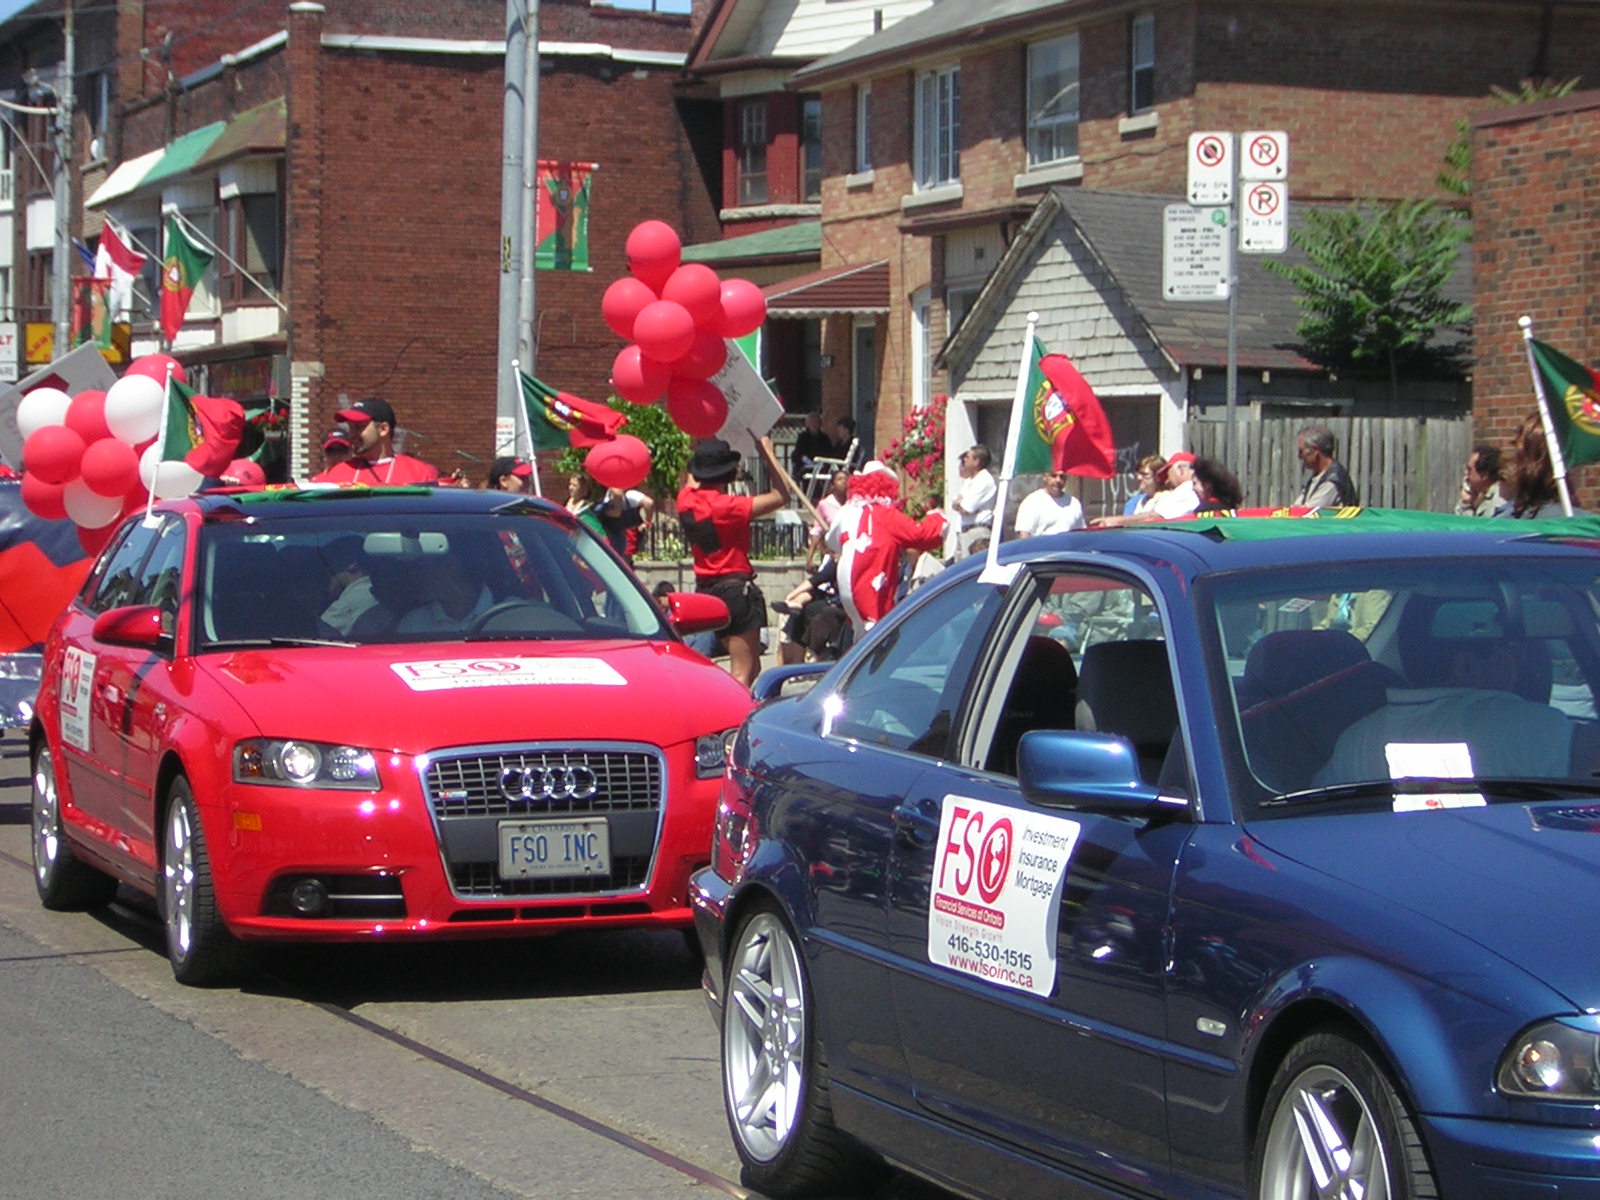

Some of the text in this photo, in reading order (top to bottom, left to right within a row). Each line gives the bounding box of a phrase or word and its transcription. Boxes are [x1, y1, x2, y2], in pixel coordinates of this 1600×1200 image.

[404, 660, 521, 678] FSO
[511, 833, 598, 864] FSO INC
[1022, 824, 1069, 850] Investment
[939, 806, 1014, 904] FSO
[1018, 848, 1057, 873] Insurance
[1014, 870, 1053, 899] Mortgage
[948, 934, 1032, 971] 416-530-1515
[948, 953, 1033, 988] www.fsoinc.ca
